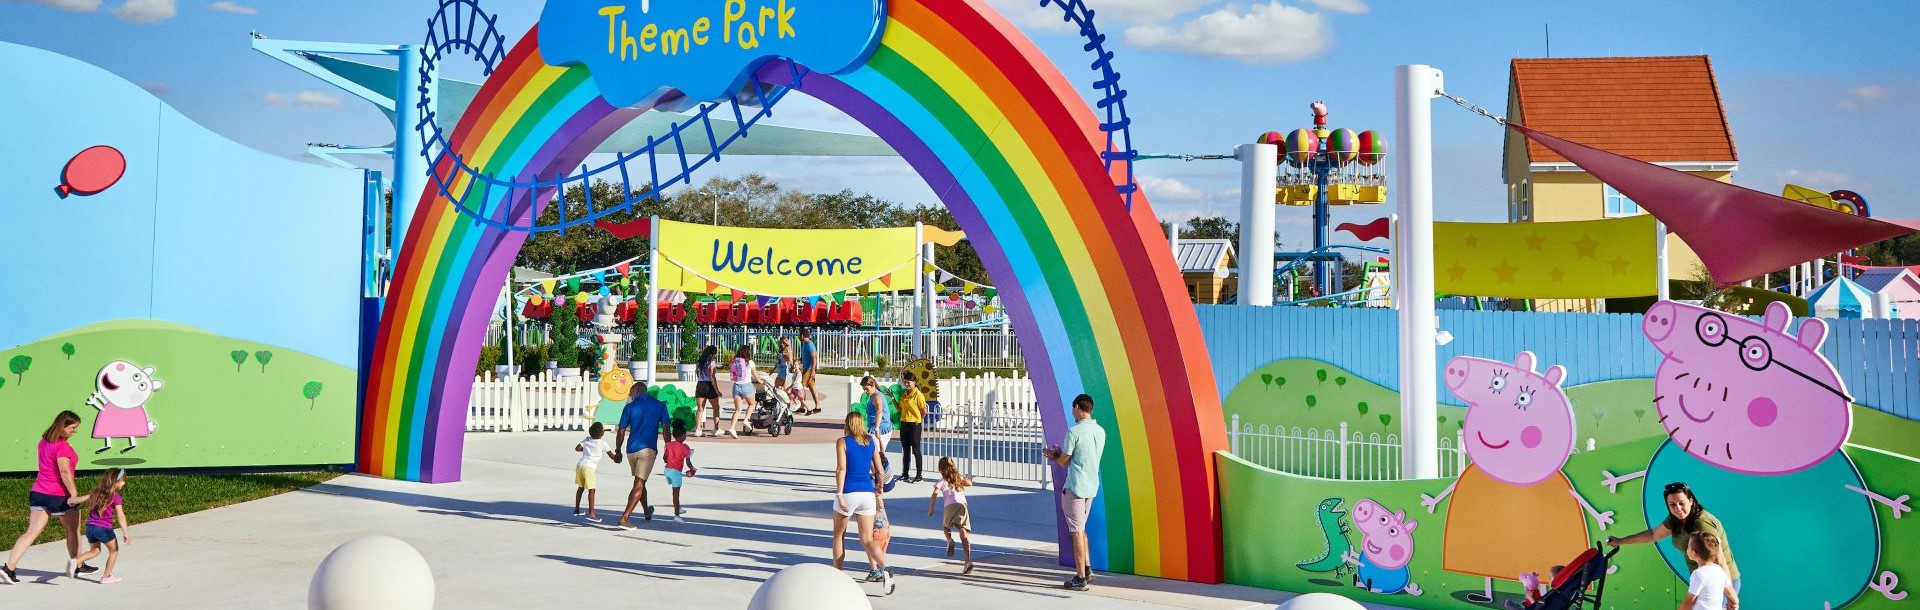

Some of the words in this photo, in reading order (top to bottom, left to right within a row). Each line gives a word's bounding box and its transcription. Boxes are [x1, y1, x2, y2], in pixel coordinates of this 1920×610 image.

[598, 5, 710, 61] Theme
[723, 0, 796, 50] Park
[711, 238, 863, 277] Welcome
